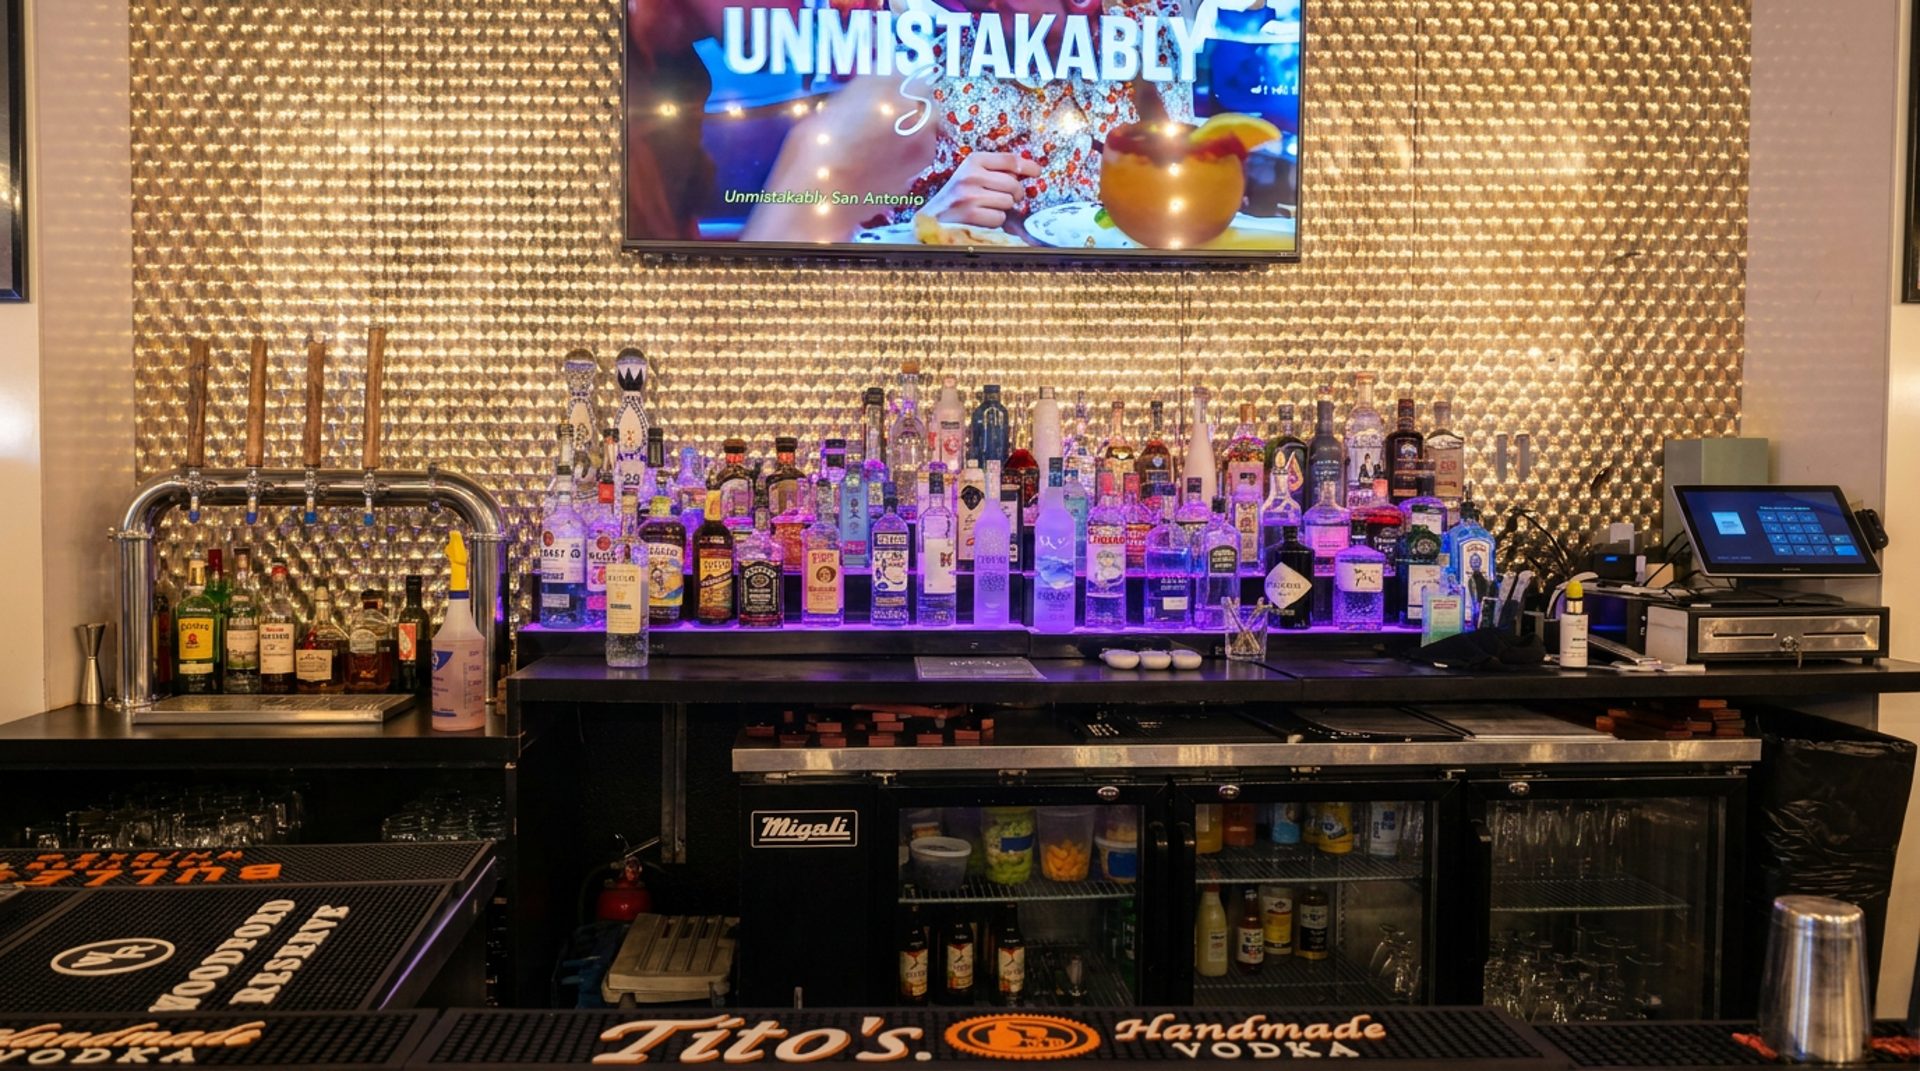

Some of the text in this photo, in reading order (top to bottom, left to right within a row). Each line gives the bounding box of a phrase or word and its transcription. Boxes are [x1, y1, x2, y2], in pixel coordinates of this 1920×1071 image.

[724, 7, 1204, 82] UNMISTAKABLY
[724, 190, 924, 206] Unmistakably San Antonio
[761, 817, 850, 841] Migali
[148, 900, 296, 1012] WOODFORD
[229, 904, 349, 1004] RESERVE
[1115, 1013, 1386, 1041] Handmade
[1172, 1041, 1360, 1059] VODKA
